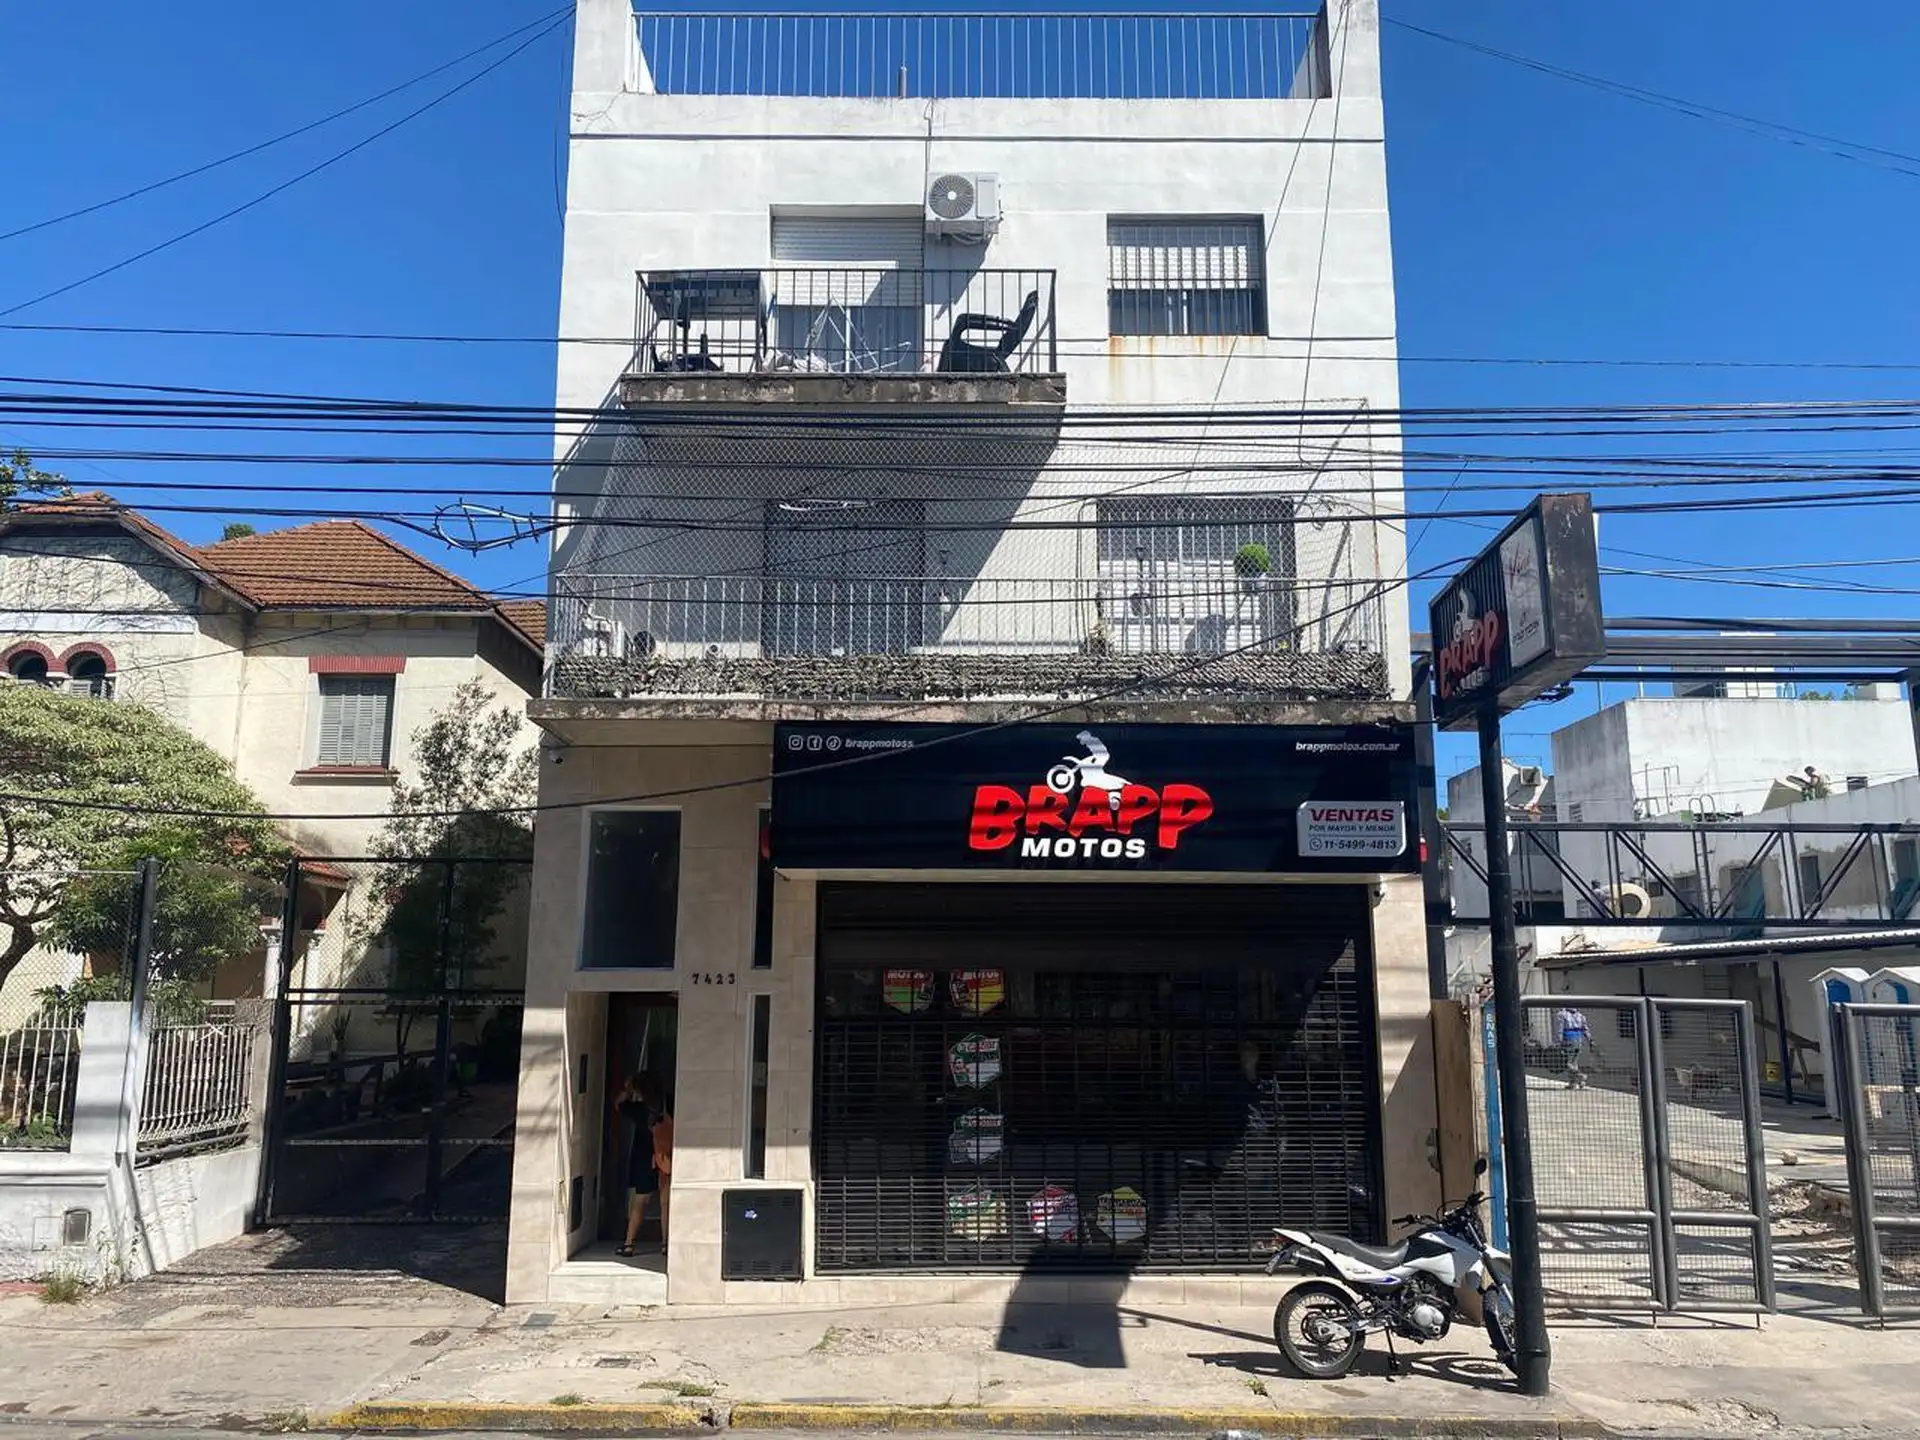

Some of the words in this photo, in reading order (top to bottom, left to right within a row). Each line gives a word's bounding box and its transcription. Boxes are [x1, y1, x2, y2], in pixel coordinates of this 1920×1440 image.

[1440, 610, 1499, 699] BRAPP
[969, 784, 1213, 849] BRAPP
[1310, 808, 1394, 822] VENTAS
[1309, 824, 1325, 832] POR
[1327, 824, 1356, 832] MAYOR
[1366, 824, 1396, 832] MENOR
[1021, 838, 1146, 858] MOTOS
[1325, 840, 1397, 850] 11-5499-4813
[692, 973, 735, 985] 7423
